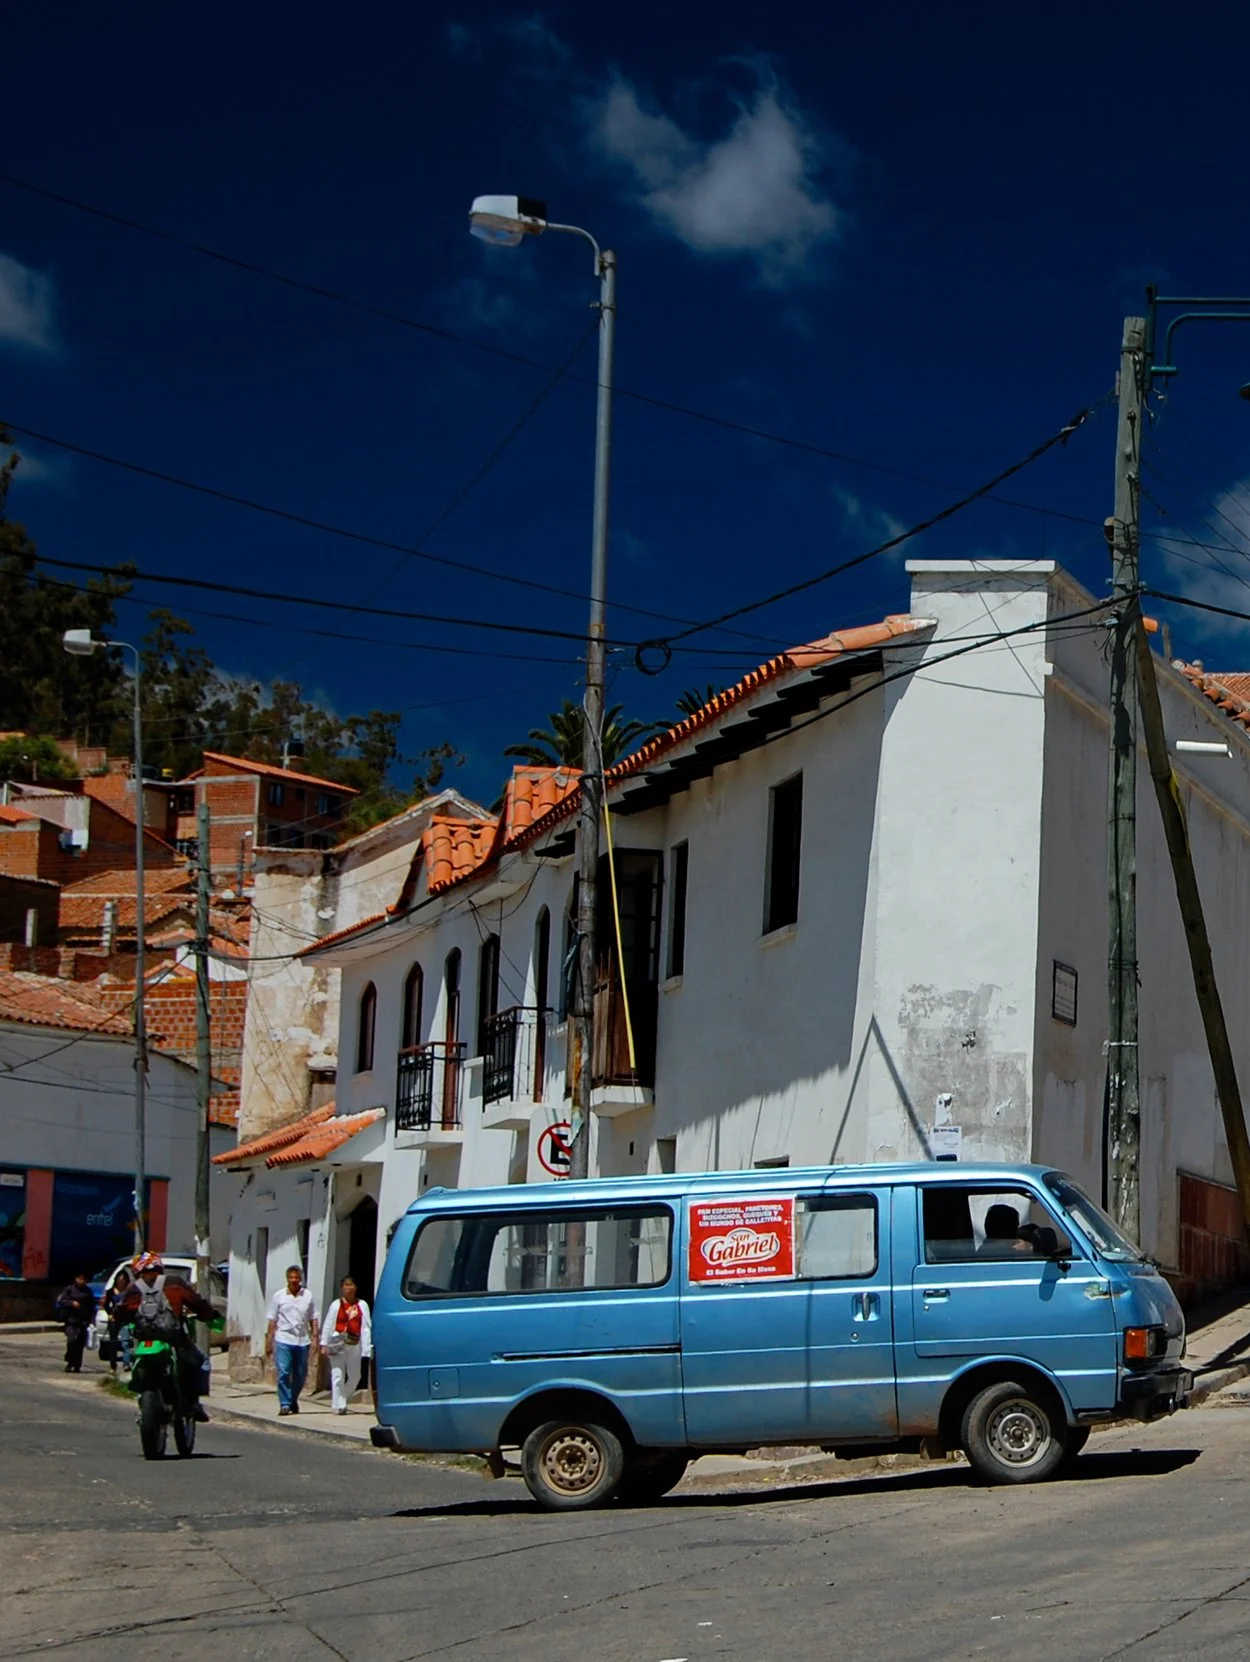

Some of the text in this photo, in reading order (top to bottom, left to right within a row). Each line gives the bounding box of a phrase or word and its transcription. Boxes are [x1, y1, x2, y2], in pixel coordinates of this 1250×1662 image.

[550, 1133, 572, 1165] E
[86, 1211, 113, 1227] entel
[709, 1234, 774, 1262] Gabriel
[730, 1233, 750, 1243] San
